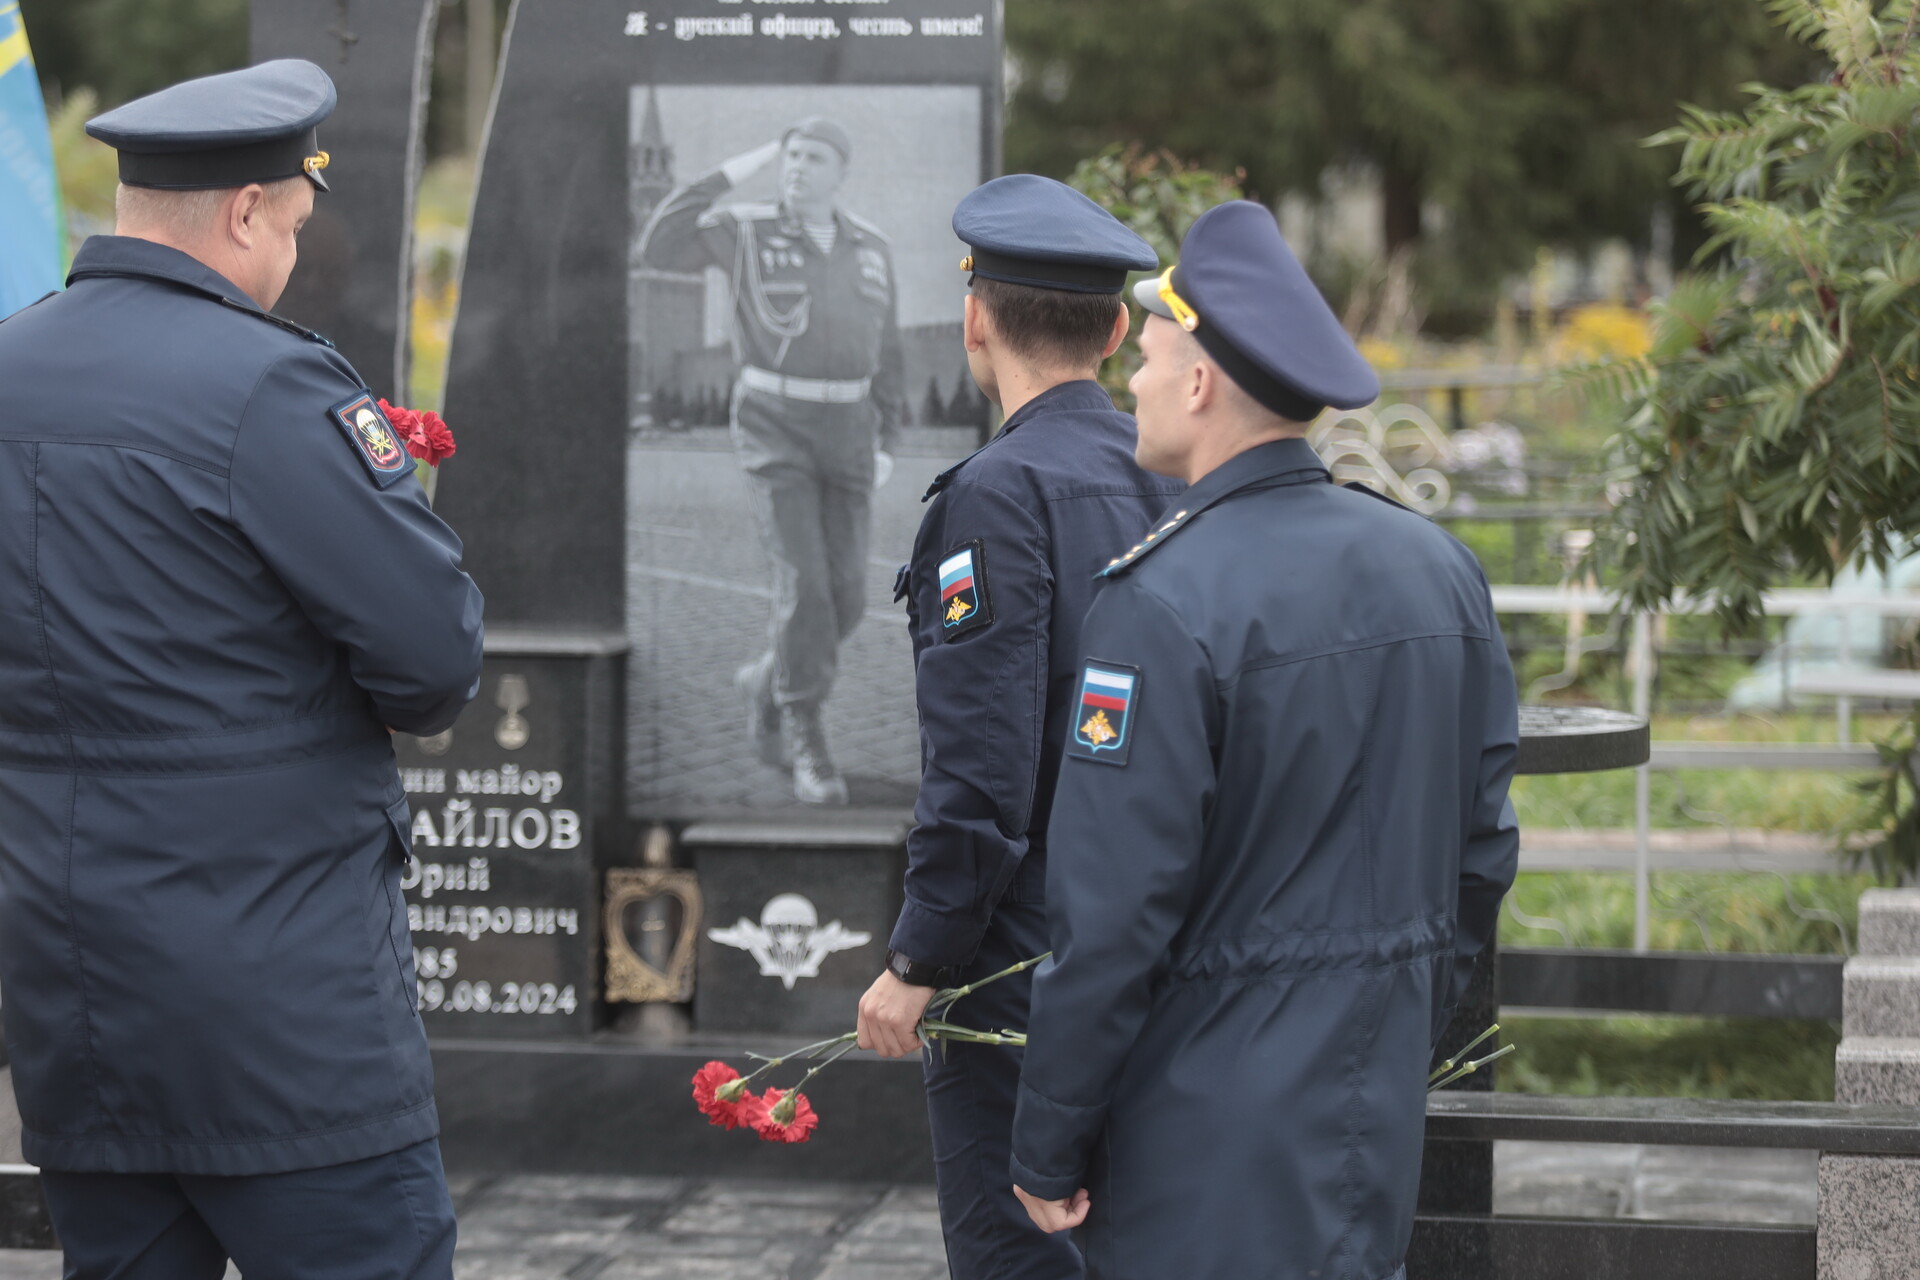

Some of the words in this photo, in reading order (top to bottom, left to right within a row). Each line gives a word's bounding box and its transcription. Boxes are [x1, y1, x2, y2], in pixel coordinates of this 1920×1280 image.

[674, 12, 754, 41] русский
[848, 17, 913, 36] честь
[456, 763, 563, 803] майор
